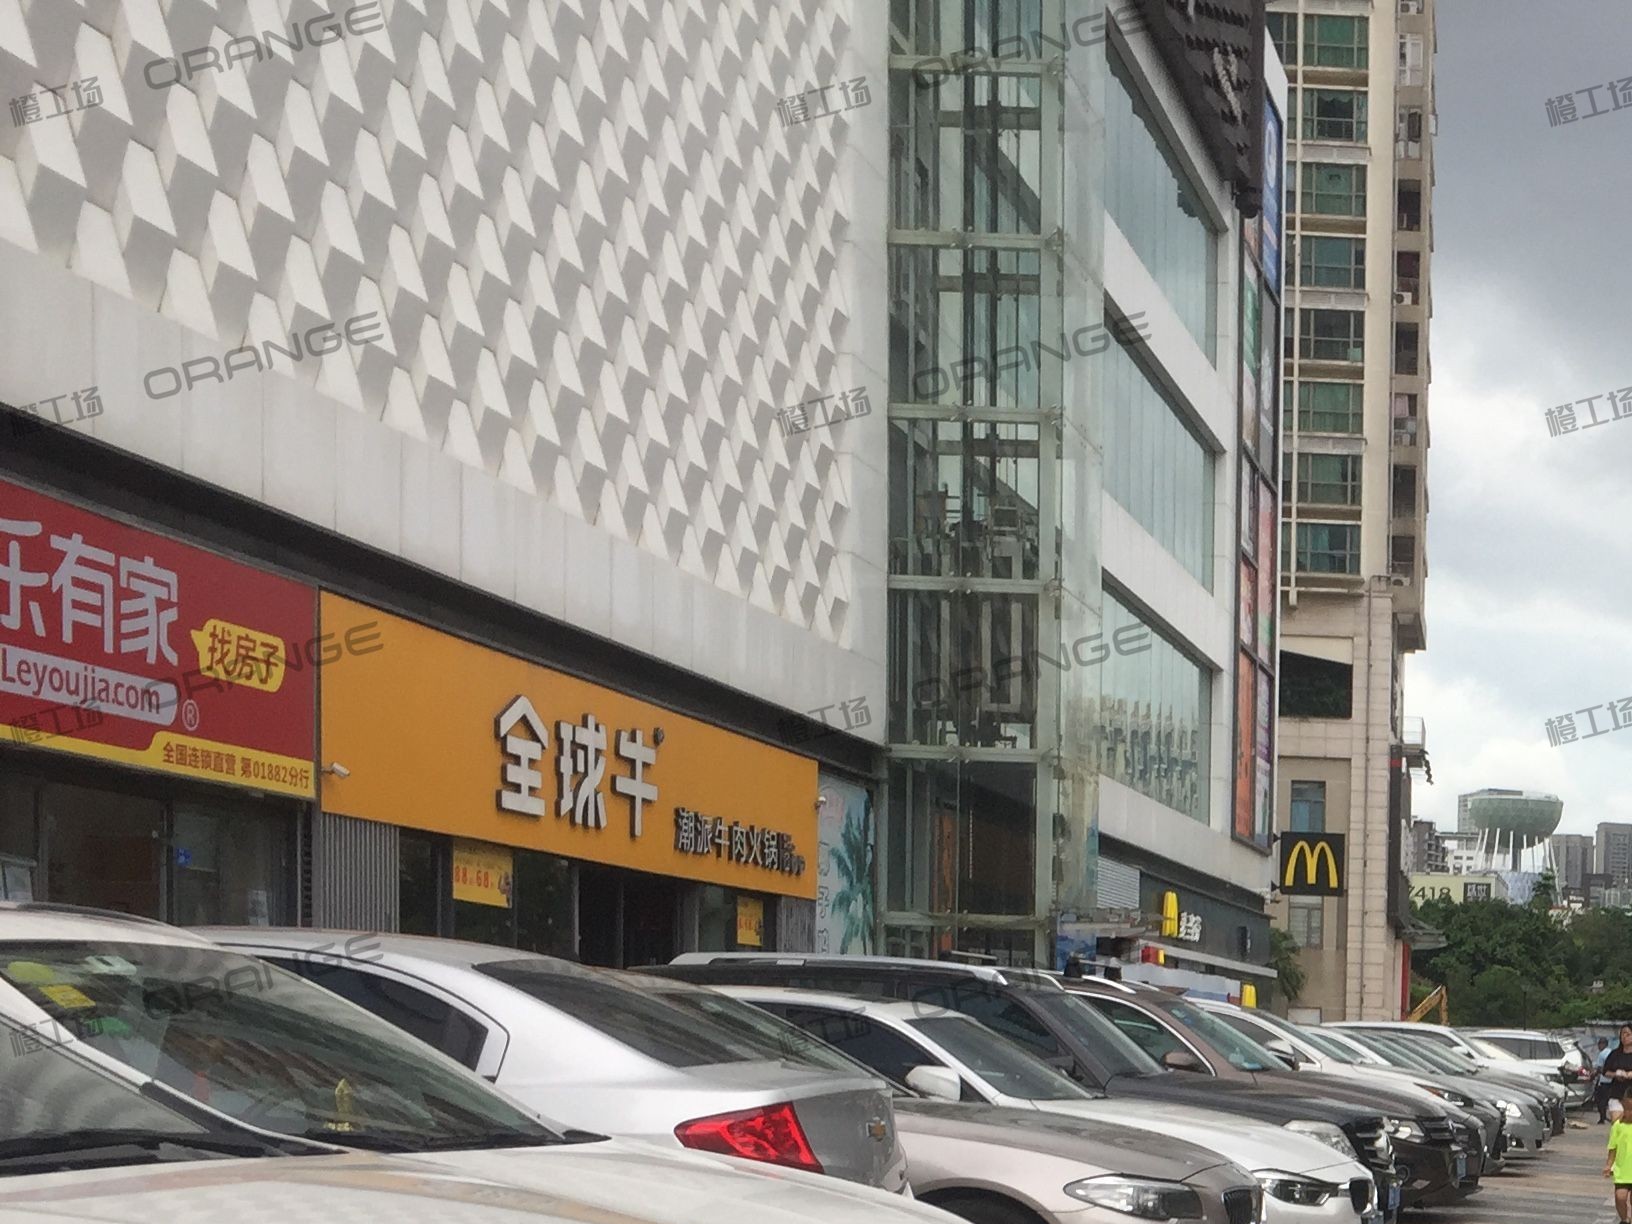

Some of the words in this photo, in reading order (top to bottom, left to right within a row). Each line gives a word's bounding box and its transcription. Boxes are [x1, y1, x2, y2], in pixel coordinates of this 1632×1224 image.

[2, 647, 160, 715] Leyoujia.com
[206, 625, 280, 685] 找房子
[495, 695, 658, 840] 全球牛
